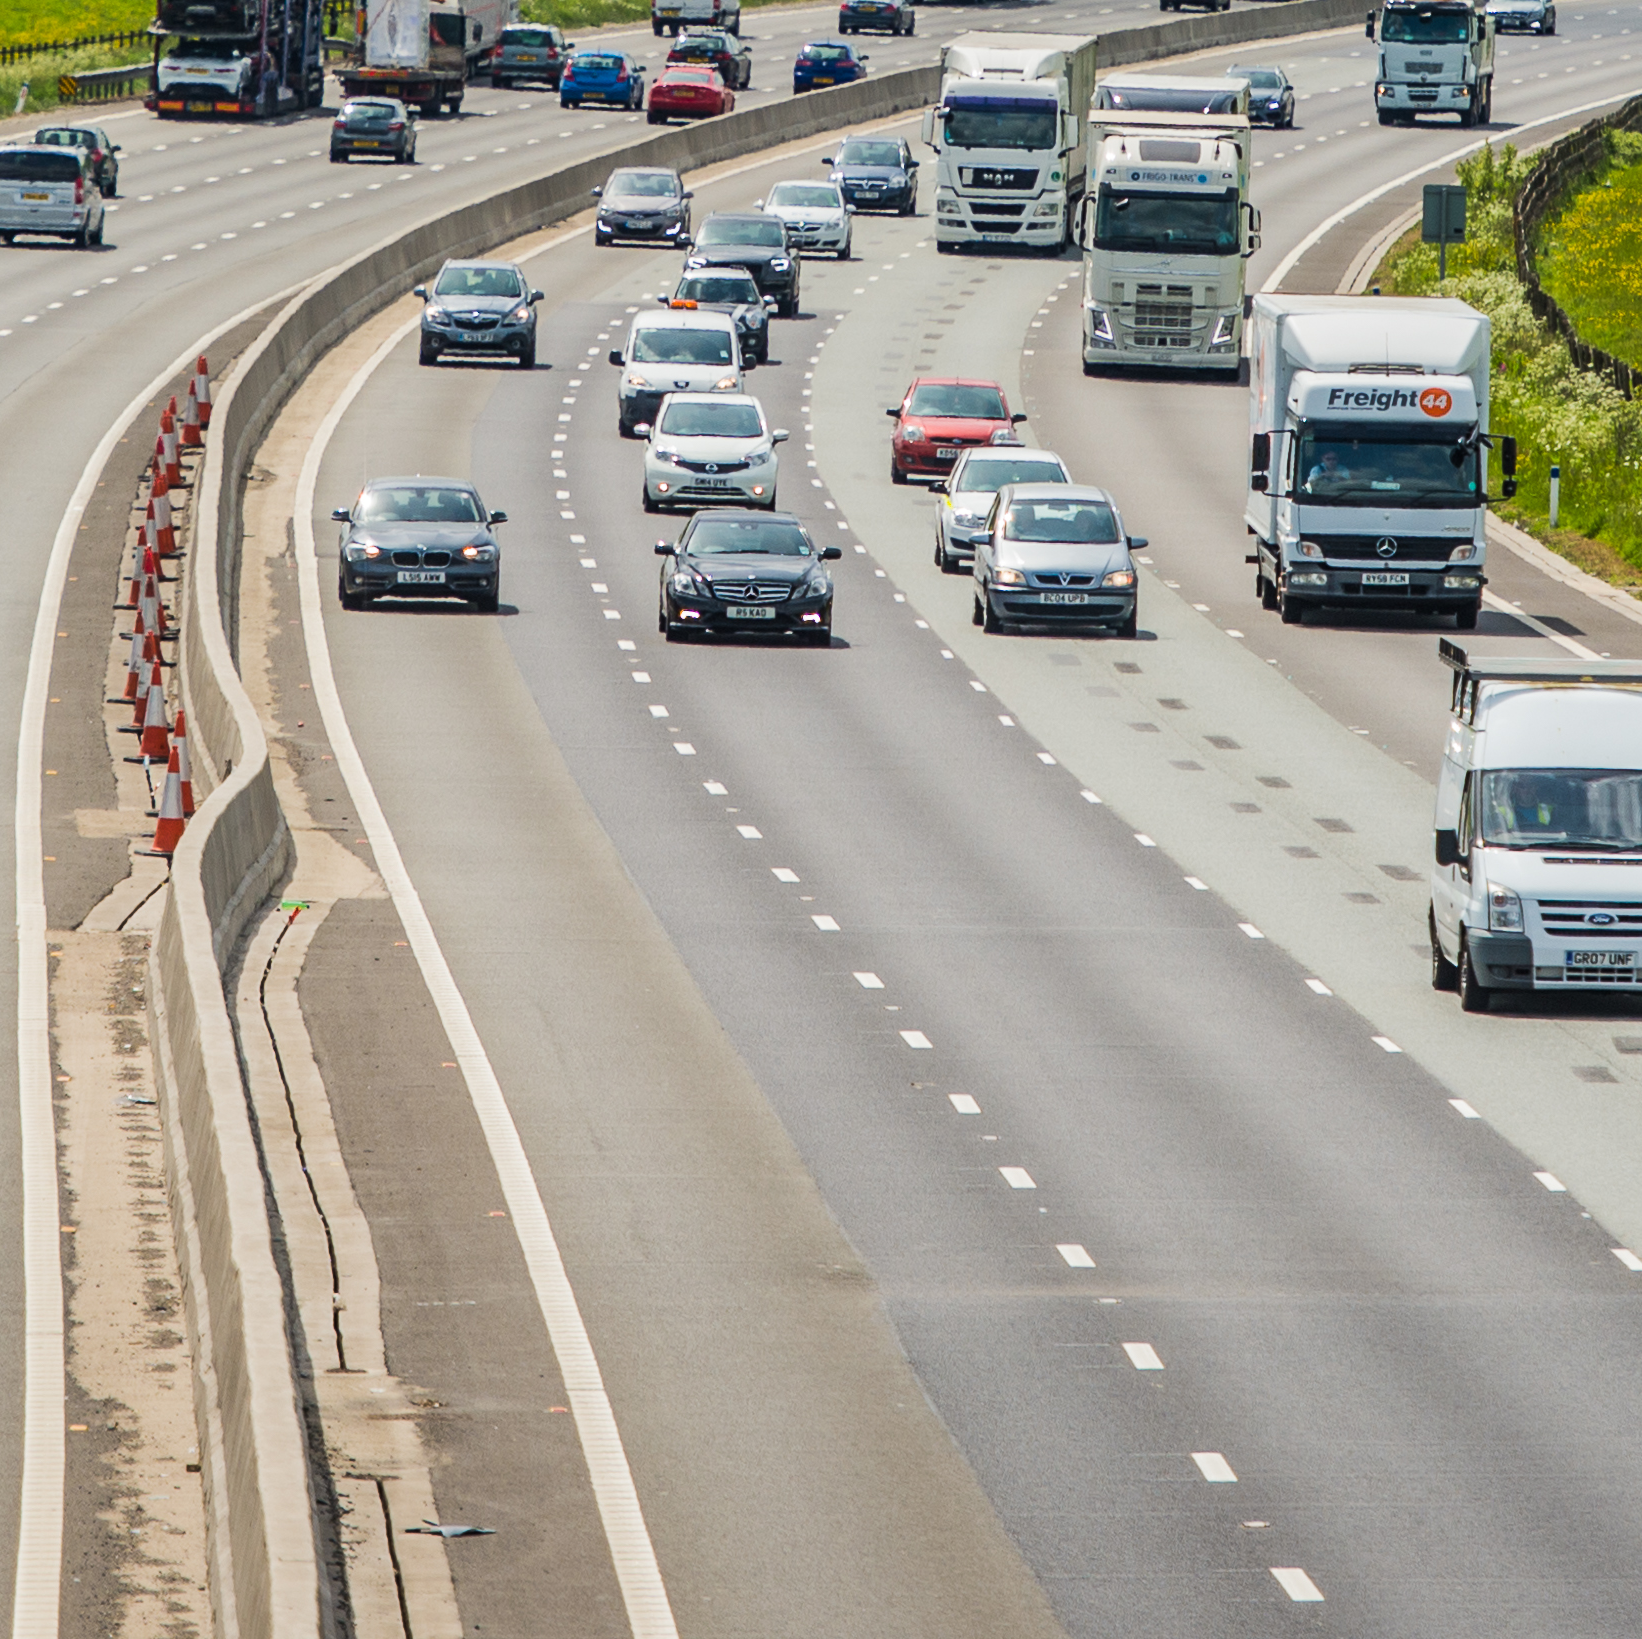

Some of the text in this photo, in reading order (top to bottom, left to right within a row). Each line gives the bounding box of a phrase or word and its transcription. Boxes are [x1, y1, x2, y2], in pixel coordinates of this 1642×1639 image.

[983, 173, 1014, 181] MAN
[1328, 388, 1448, 411] Freight 44
[1574, 953, 1634, 965] GR07 UNF
